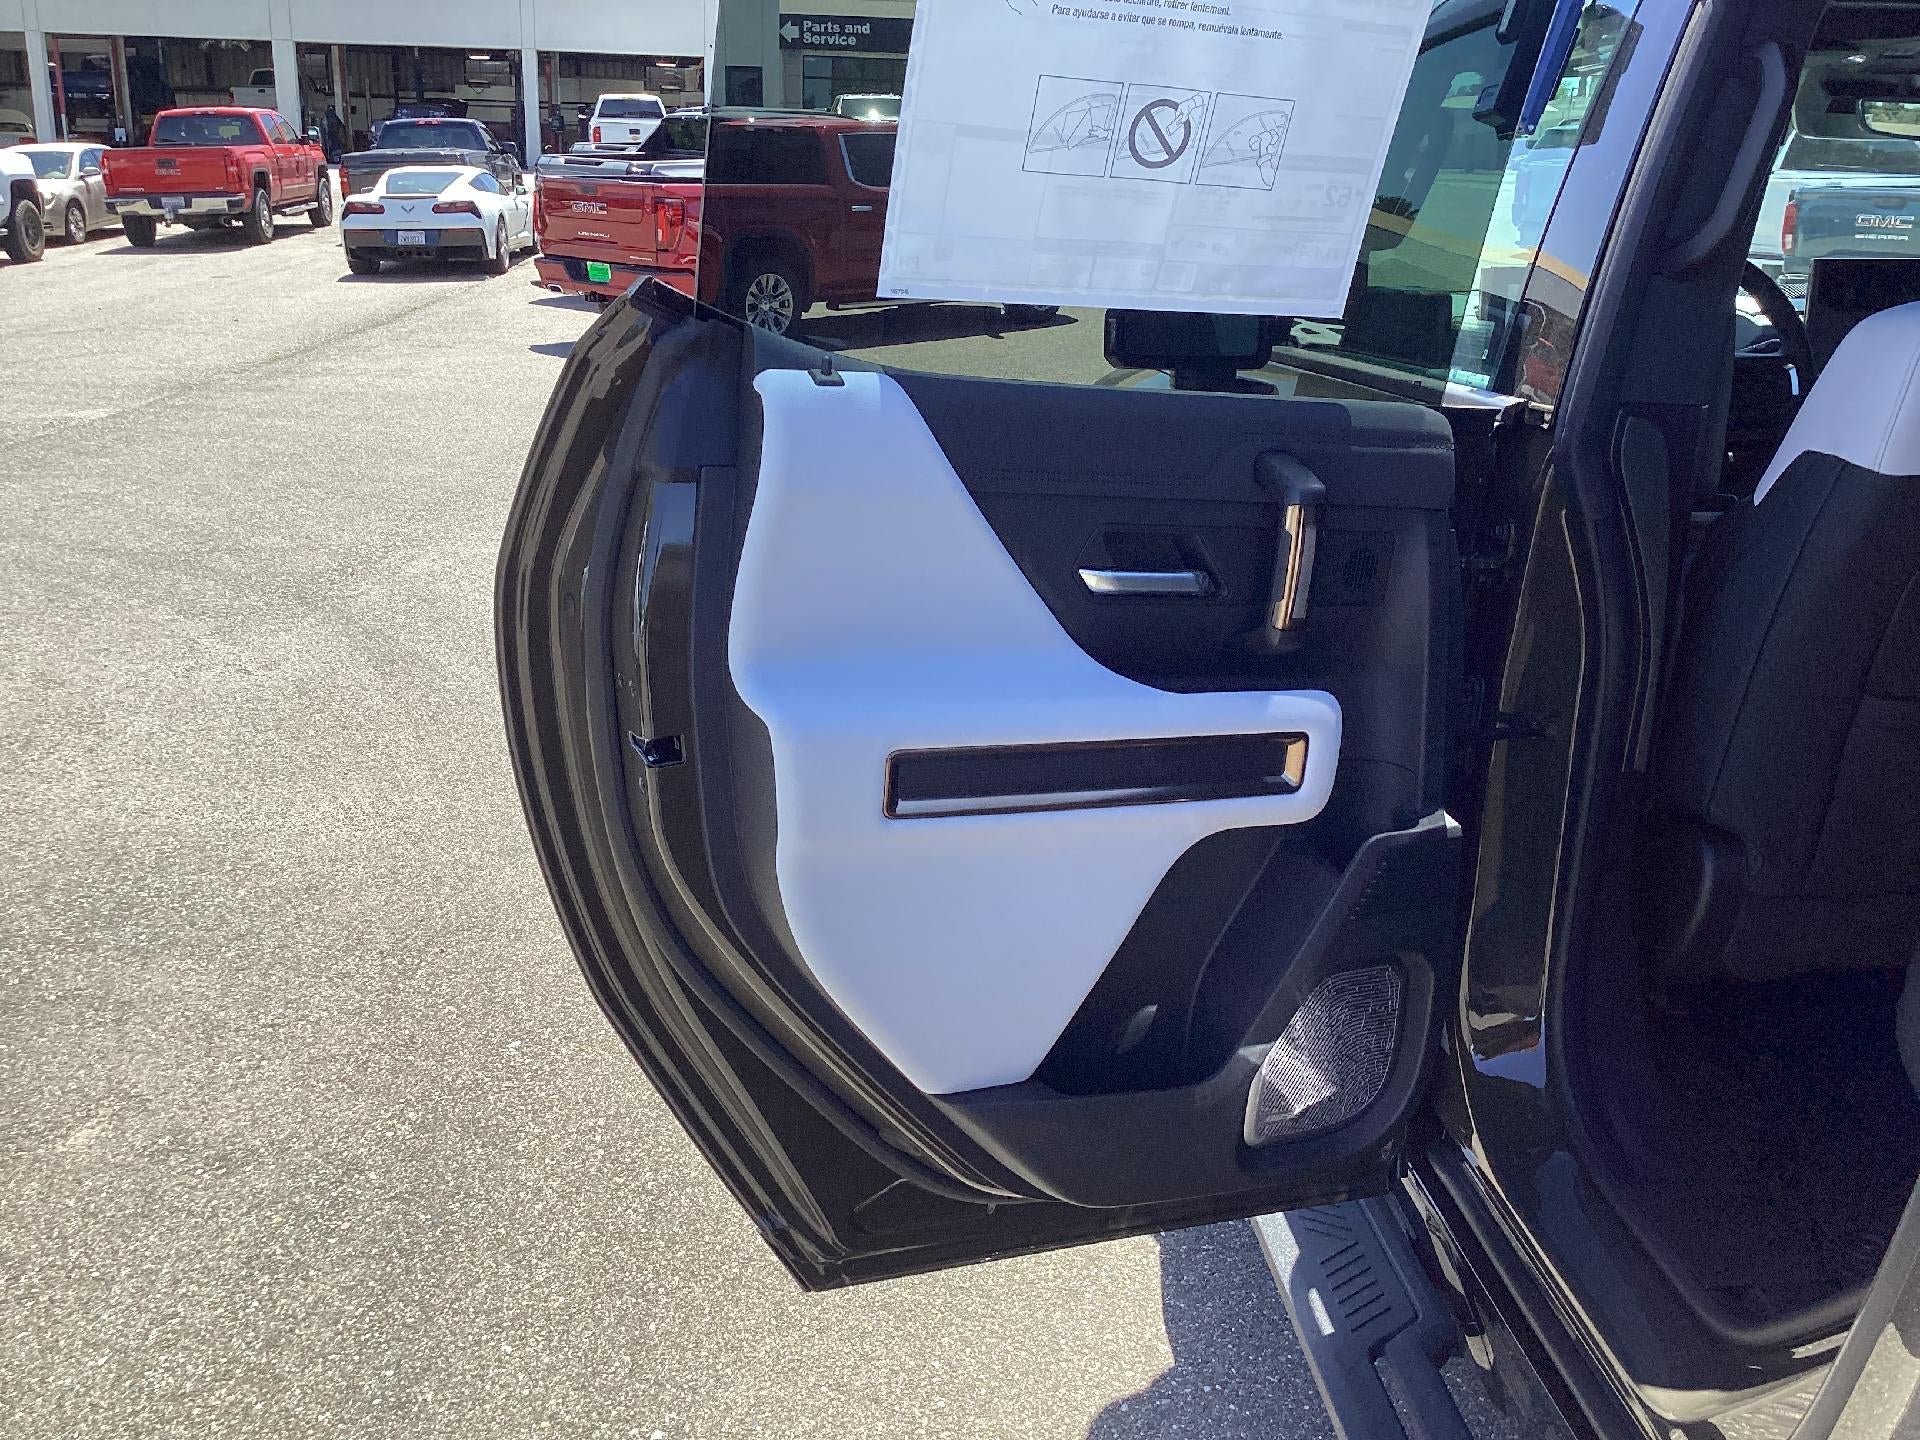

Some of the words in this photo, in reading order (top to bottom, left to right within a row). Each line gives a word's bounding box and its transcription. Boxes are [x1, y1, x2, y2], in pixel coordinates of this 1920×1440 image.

[1164, 0, 1188, 10] retirer
[1190, 2, 1231, 16] lentement.
[1051, 4, 1070, 15] Para
[1073, 8, 1109, 20] ayudarse
[1118, 11, 1140, 23] evitar
[1142, 16, 1156, 26] que
[1158, 17, 1167, 26] se
[1169, 18, 1196, 31] rompa,
[803, 20, 840, 32] Parts
[845, 23, 871, 34] and
[803, 32, 856, 45] Service
[573, 201, 607, 214] GMC
[1855, 214, 1914, 229] GMC
